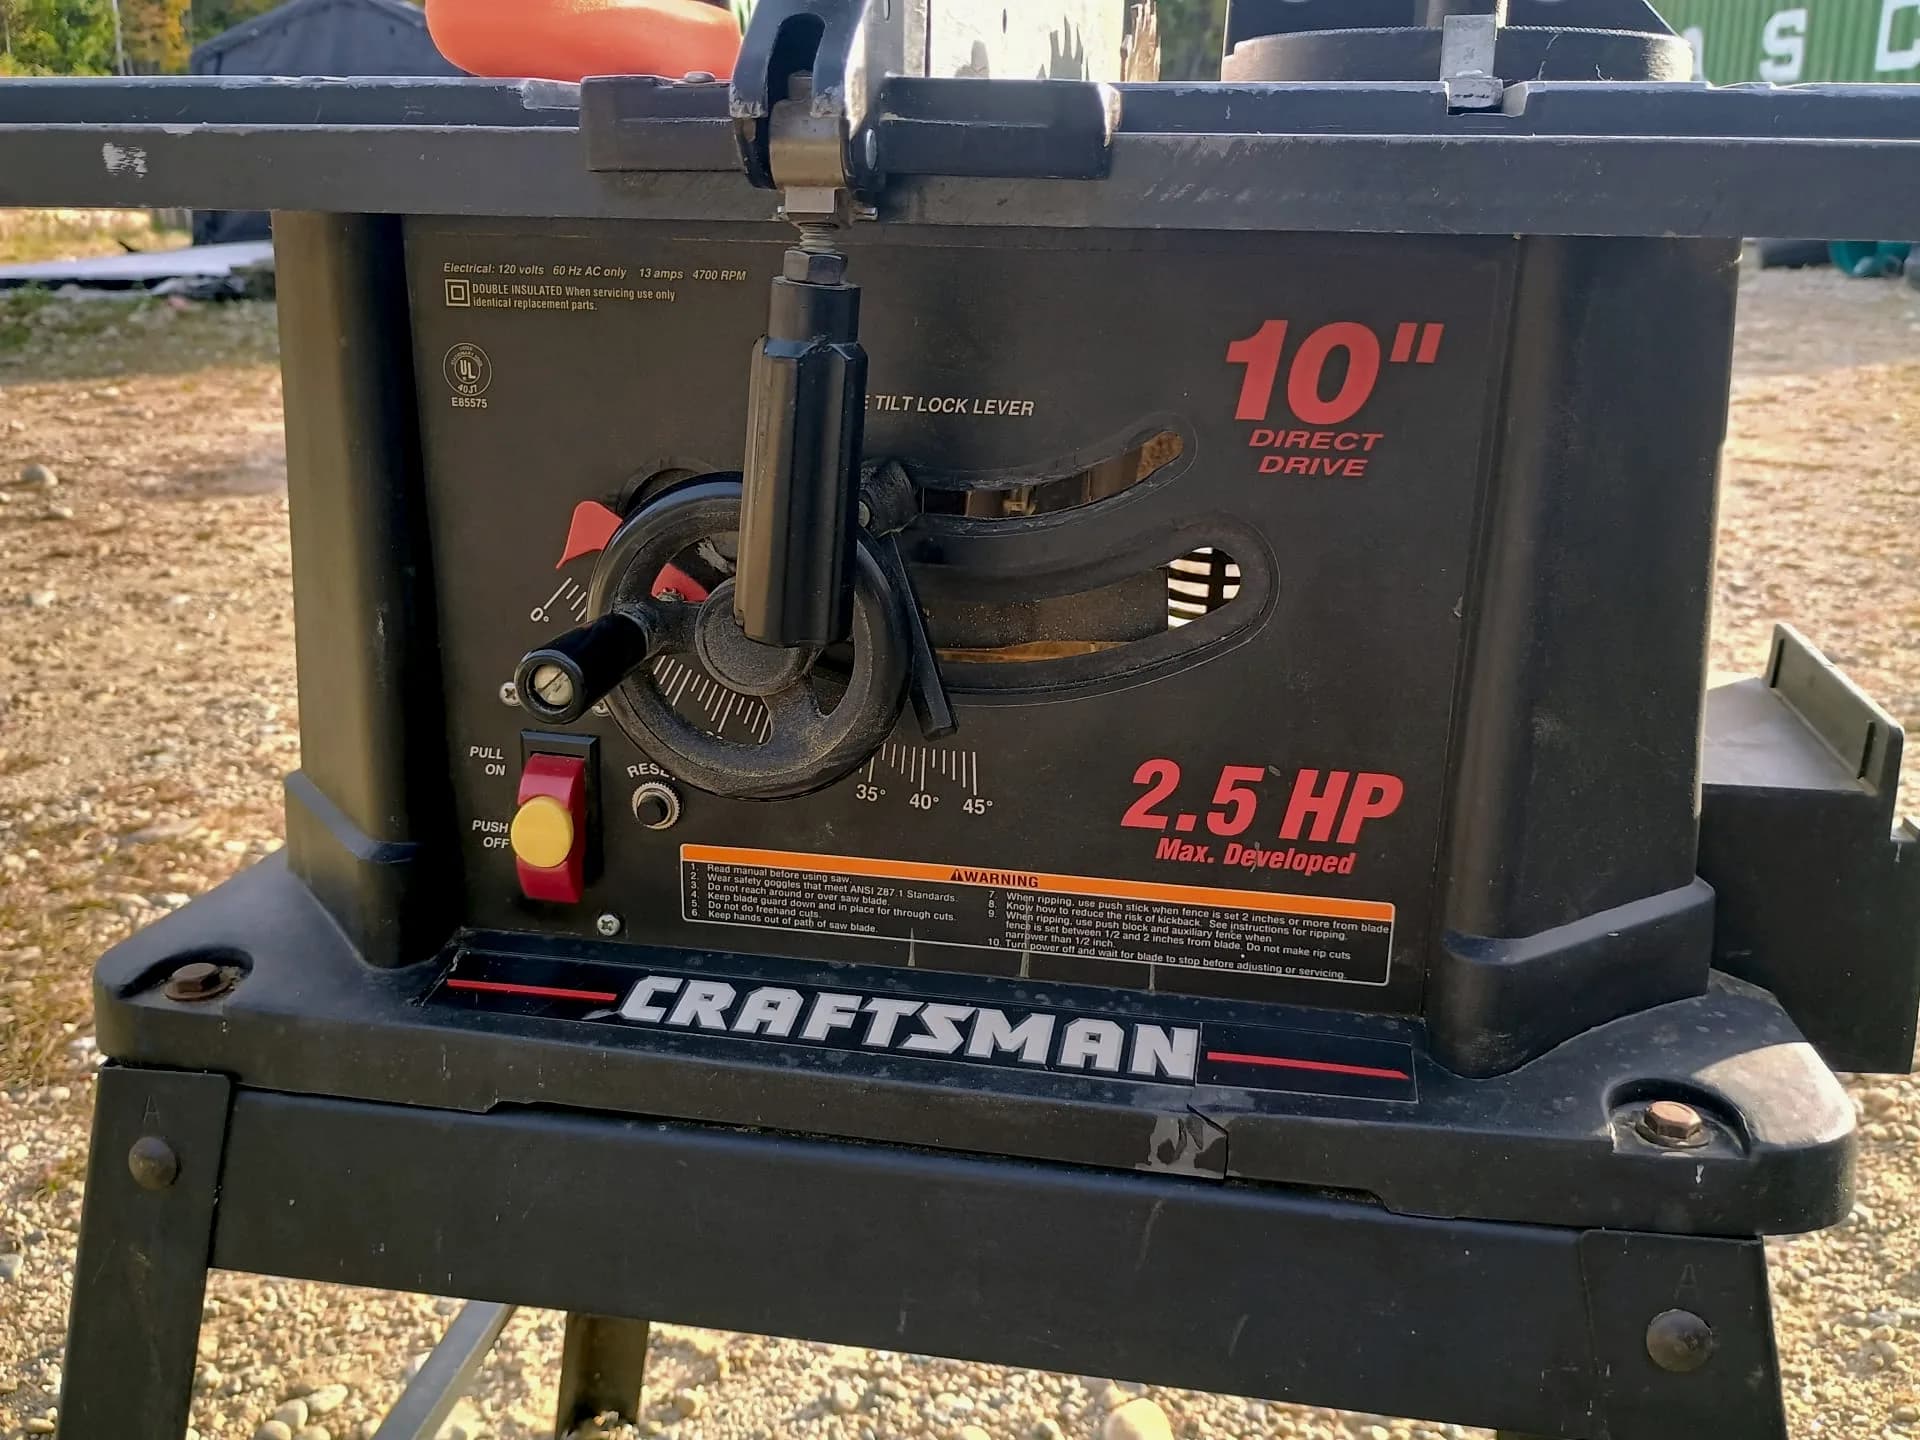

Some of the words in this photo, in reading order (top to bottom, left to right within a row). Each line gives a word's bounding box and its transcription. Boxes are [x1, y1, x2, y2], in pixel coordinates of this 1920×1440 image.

[443, 263, 494, 274] Electrical:
[498, 264, 517, 274] 120
[519, 265, 544, 275] volts
[552, 265, 566, 276] 60
[568, 266, 582, 276] Hz
[584, 266, 601, 277] AC
[603, 267, 627, 278] only
[639, 268, 651, 278] 13
[653, 270, 683, 280] amps
[692, 269, 718, 280] 4700
[721, 270, 747, 281] RPM
[472, 283, 509, 295] DOUBLE
[511, 285, 563, 296] INSULATED
[565, 286, 591, 297] When
[593, 288, 635, 300] servicing
[638, 291, 653, 299] use
[656, 290, 675, 302] only
[473, 298, 511, 308] identical
[514, 299, 569, 311] replacement
[572, 300, 598, 311] parts.
[1226, 319, 1445, 425] 10"
[451, 397, 488, 408] E85575
[875, 395, 914, 411] TILT
[917, 397, 968, 414] LOCK
[973, 399, 1035, 416] LEVER
[1249, 429, 1385, 452] DIRECT
[1258, 456, 1369, 478] DRIVE
[470, 746, 505, 760] PULL
[485, 764, 506, 776] ON
[1120, 758, 1265, 837] 2.5
[1278, 768, 1404, 844] HP
[472, 819, 509, 833] PUSH
[483, 837, 511, 849] OFF
[1155, 837, 1214, 864] Max.
[1223, 843, 1357, 876] Developed
[706, 863, 731, 873] Read
[732, 866, 767, 876] manual
[769, 869, 799, 878] before
[801, 871, 828, 883] using
[964, 870, 1038, 887] WARNING
[706, 873, 731, 883] Wear
[733, 875, 762, 887] safety
[763, 878, 801, 891] goggles
[803, 881, 821, 891] that
[823, 883, 847, 893] meet
[849, 885, 874, 895] ANSI
[876, 887, 903, 898] Z87.1
[707, 882, 721, 891] Do
[723, 883, 738, 892] not
[740, 885, 766, 895] reach
[768, 887, 802, 898] around
[816, 893, 838, 901] over
[840, 895, 860, 903] saw
[707, 892, 731, 903] Keep
[732, 894, 758, 904] blade
[760, 896, 787, 908] guard
[789, 899, 816, 909] down
[817, 901, 836, 911] and
[837, 903, 847, 912] in
[849, 904, 875, 916] place
[876, 907, 891, 915] for
[892, 908, 931, 921] through
[708, 901, 721, 909] Do
[723, 902, 738, 911] not
[741, 904, 753, 912] do
[756, 905, 796, 916] freehand
[1006, 892, 1035, 903] When
[1077, 900, 1095, 908] use
[1097, 900, 1123, 912] push
[1125, 902, 1149, 912] stick
[1151, 904, 1179, 915] when
[1181, 907, 1209, 918] fence
[1211, 909, 1221, 919] is
[1223, 910, 1239, 920] set
[1241, 912, 1249, 921] 2
[1251, 913, 1286, 924] inches
[1302, 919, 1330, 928] more
[1332, 920, 1359, 931] from
[707, 910, 731, 921] Keep
[733, 912, 761, 922] hands
[763, 915, 779, 924] out
[781, 916, 791, 925] of
[793, 917, 814, 929] path
[816, 919, 826, 928] of
[828, 922, 848, 930] saw
[1005, 902, 1033, 912] Know
[1035, 904, 1056, 914] how
[1058, 906, 1069, 915] to
[1071, 907, 1104, 918] reduce
[1106, 910, 1122, 919] the
[1124, 912, 1143, 921] risk
[1144, 914, 1156, 922] of
[1208, 919, 1228, 929] See
[1229, 921, 1290, 934] instructions
[1291, 926, 1307, 936] for
[1033, 923, 1042, 932] is
[1044, 924, 1059, 933] set
[1061, 926, 1101, 937] between
[1104, 929, 1120, 939] 1/2
[1122, 931, 1141, 941] and
[1142, 933, 1150, 942] 2
[1152, 934, 1184, 945] inches
[1187, 937, 1211, 947] from
[1246, 942, 1261, 951] Do
[1263, 943, 1280, 953] not
[1282, 945, 1310, 956] make
[1312, 948, 1327, 959] rip
[1328, 949, 1351, 959] cuts
[1050, 934, 1072, 944] than
[1074, 936, 1090, 945] 1/2
[1075, 919, 1093, 927] use
[1095, 919, 1119, 931] push
[1121, 921, 1148, 931] block
[1150, 924, 1169, 933] and
[1171, 926, 1213, 939] auxiliary
[1214, 929, 1242, 940] fence
[1244, 932, 1272, 942] when
[1029, 944, 1059, 954] power
[1061, 945, 1075, 954] off
[1076, 946, 1095, 956] and
[1097, 948, 1118, 958] wait
[1120, 950, 1134, 959] for
[1136, 951, 1163, 962] blade
[1165, 954, 1176, 963] to
[1177, 955, 1200, 967] stop
[1202, 957, 1234, 968] before
[1236, 960, 1283, 974] adjusting
[1284, 966, 1296, 974] or
[620, 974, 1200, 1082] CRAFTSMAN
